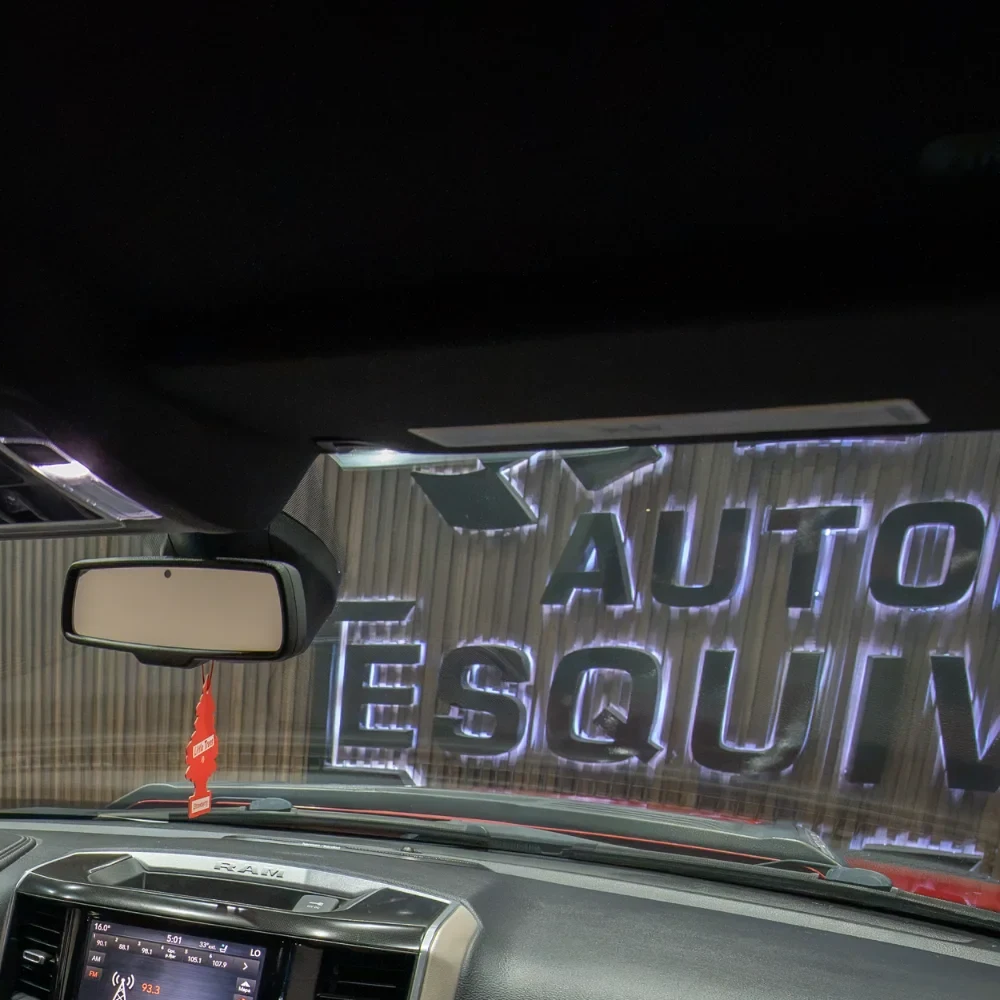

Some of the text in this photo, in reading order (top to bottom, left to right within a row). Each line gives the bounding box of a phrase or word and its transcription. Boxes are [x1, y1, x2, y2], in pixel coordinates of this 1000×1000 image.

[540, 500, 988, 611] AUTO
[213, 862, 285, 878] RAM
[94, 922, 111, 932] 16.0°
[166, 934, 182, 945] 5:01
[250, 948, 261, 958] LO
[91, 955, 102, 963] AM
[187, 955, 202, 963] 105.1
[212, 960, 228, 968] 107.9
[88, 970, 98, 978] FM
[141, 982, 160, 995] 93.3
